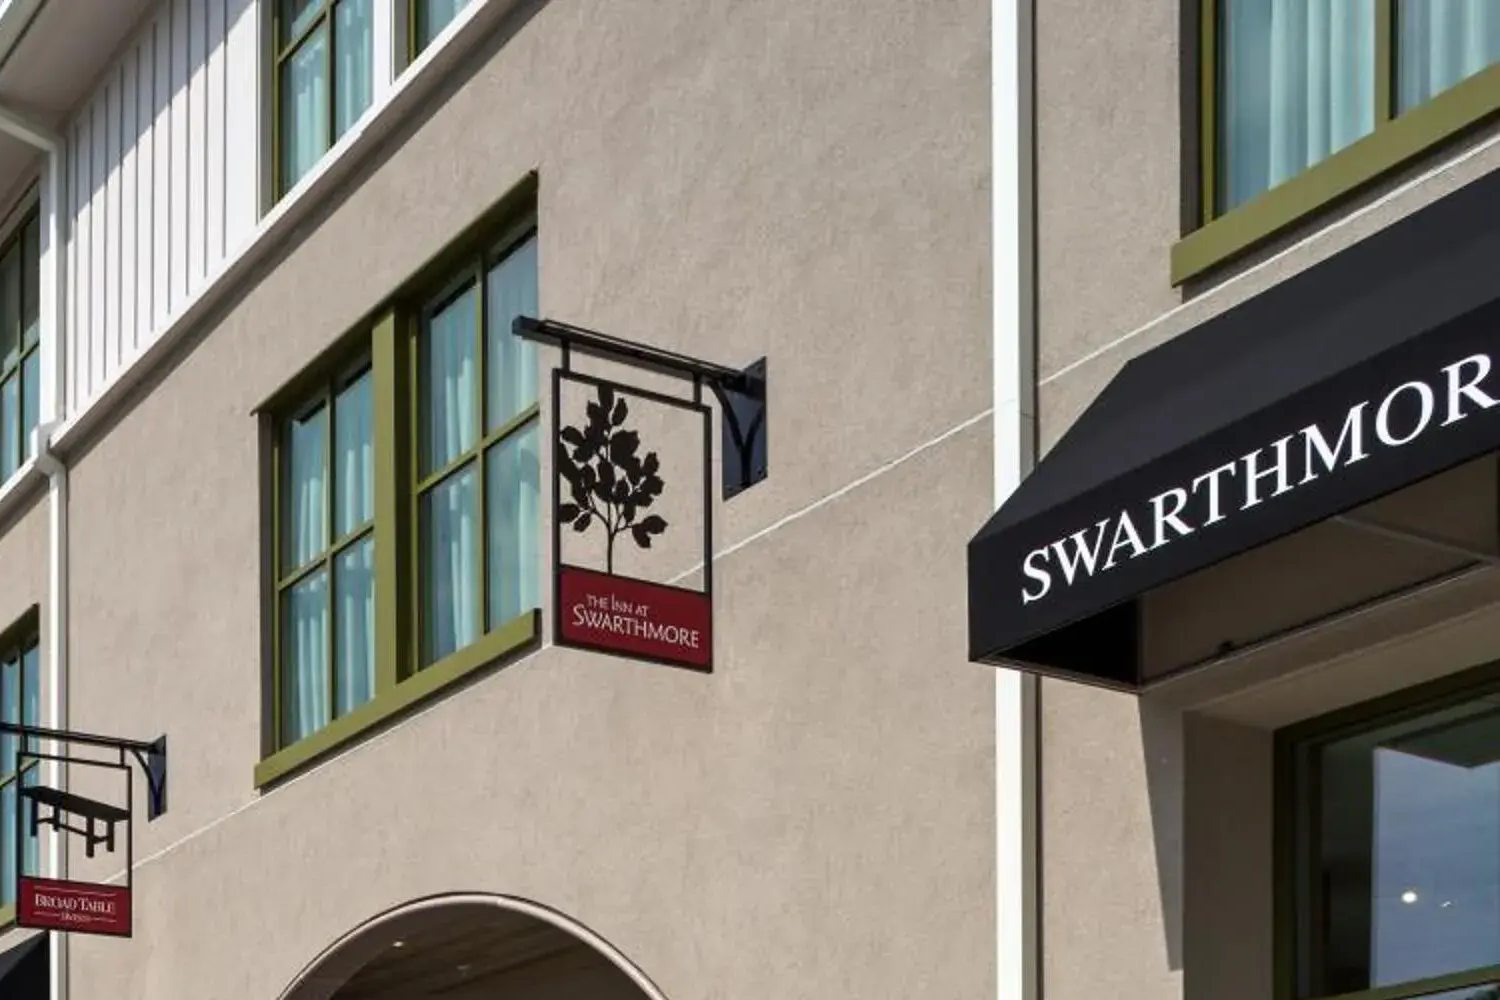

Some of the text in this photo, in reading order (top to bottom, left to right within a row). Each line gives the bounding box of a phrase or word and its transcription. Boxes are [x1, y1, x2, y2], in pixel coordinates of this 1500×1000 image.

[587, 592, 650, 618] THE INN AT
[572, 604, 700, 648] SWARTHMORE
[35, 893, 117, 914] BROAD TABLE
